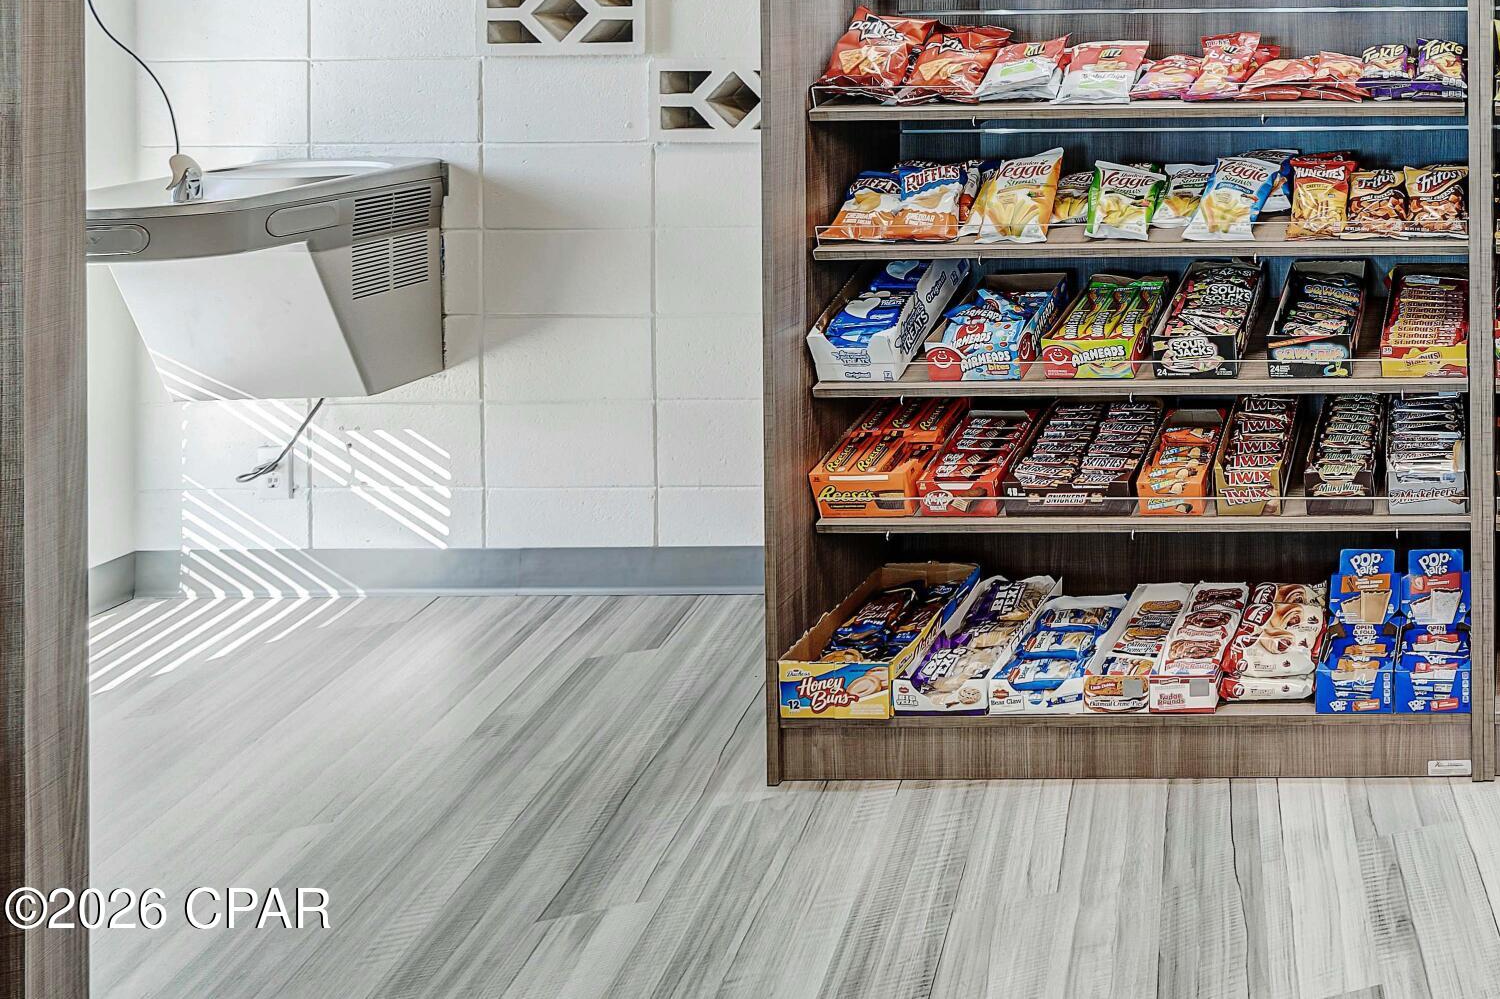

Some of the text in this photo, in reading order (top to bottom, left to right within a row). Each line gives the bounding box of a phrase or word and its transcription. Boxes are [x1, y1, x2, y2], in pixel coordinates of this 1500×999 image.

[904, 166, 960, 191] RUFFLES
[996, 161, 1052, 182] Veggie
[1217, 160, 1269, 183] Veggie
[1418, 170, 1458, 193] Fritos
[1172, 338, 1206, 350] SOUR
[1071, 345, 1126, 368] AIRHEADS
[1175, 346, 1214, 358] JACKS
[961, 351, 1011, 372] AIRHEADS
[988, 361, 1010, 370] bites
[1269, 364, 1281, 373] 24
[1156, 368, 1168, 376] 24
[1241, 418, 1285, 433] TWIX
[1228, 470, 1273, 484] TWIX
[818, 485, 875, 502] Reese's
[1045, 493, 1088, 504] SNICKERS
[1221, 487, 1274, 505] TWIX
[1399, 487, 1458, 502] Musketeers
[798, 676, 844, 696] Honey
[788, 700, 800, 709] 12
[811, 690, 856, 711] Buns
[1089, 699, 1113, 707] Oatmeal
[1159, 693, 1183, 701] Fudge
